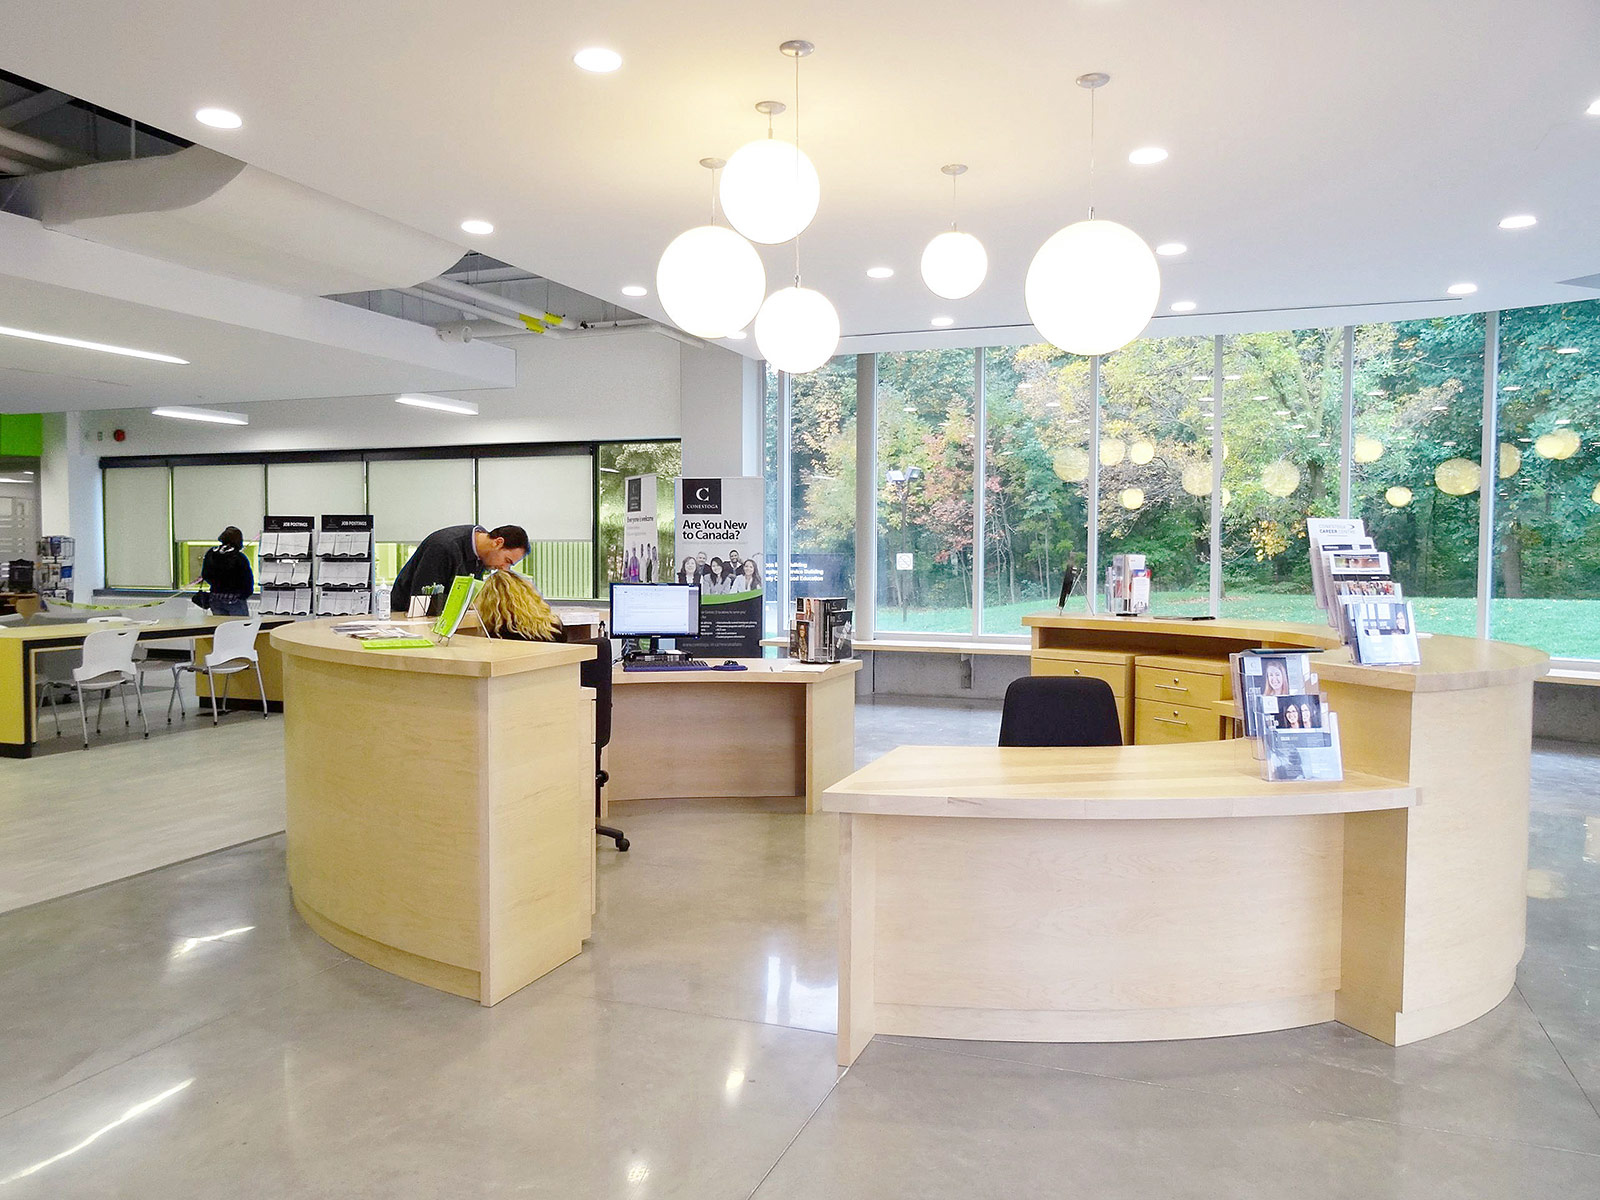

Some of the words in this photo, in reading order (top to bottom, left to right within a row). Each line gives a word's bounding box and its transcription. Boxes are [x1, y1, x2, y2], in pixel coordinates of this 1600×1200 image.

[695, 487, 710, 501] C
[682, 520, 701, 530] Are
[702, 520, 722, 530] You
[723, 520, 748, 530] New
[682, 531, 694, 540] to
[695, 530, 741, 540] Canada?
